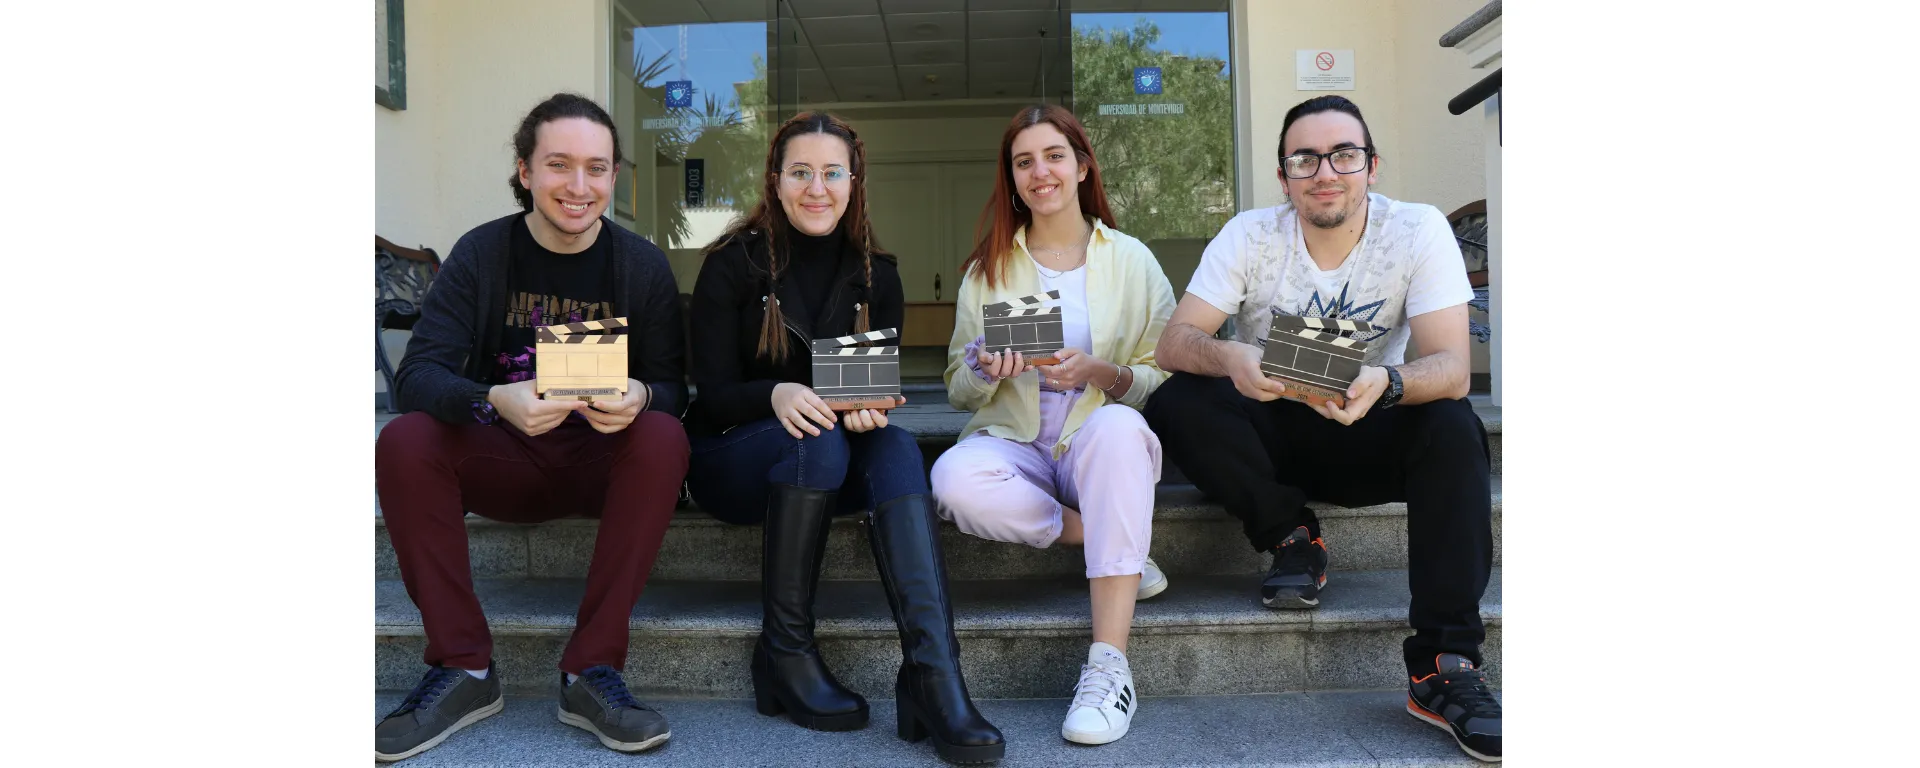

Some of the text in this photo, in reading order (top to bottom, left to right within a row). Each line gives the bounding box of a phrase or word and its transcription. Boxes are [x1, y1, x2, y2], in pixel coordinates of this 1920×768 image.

[1099, 103, 1183, 115] UNIVERSIDAD DE MONTEVIDEO
[689, 168, 700, 188] 003
